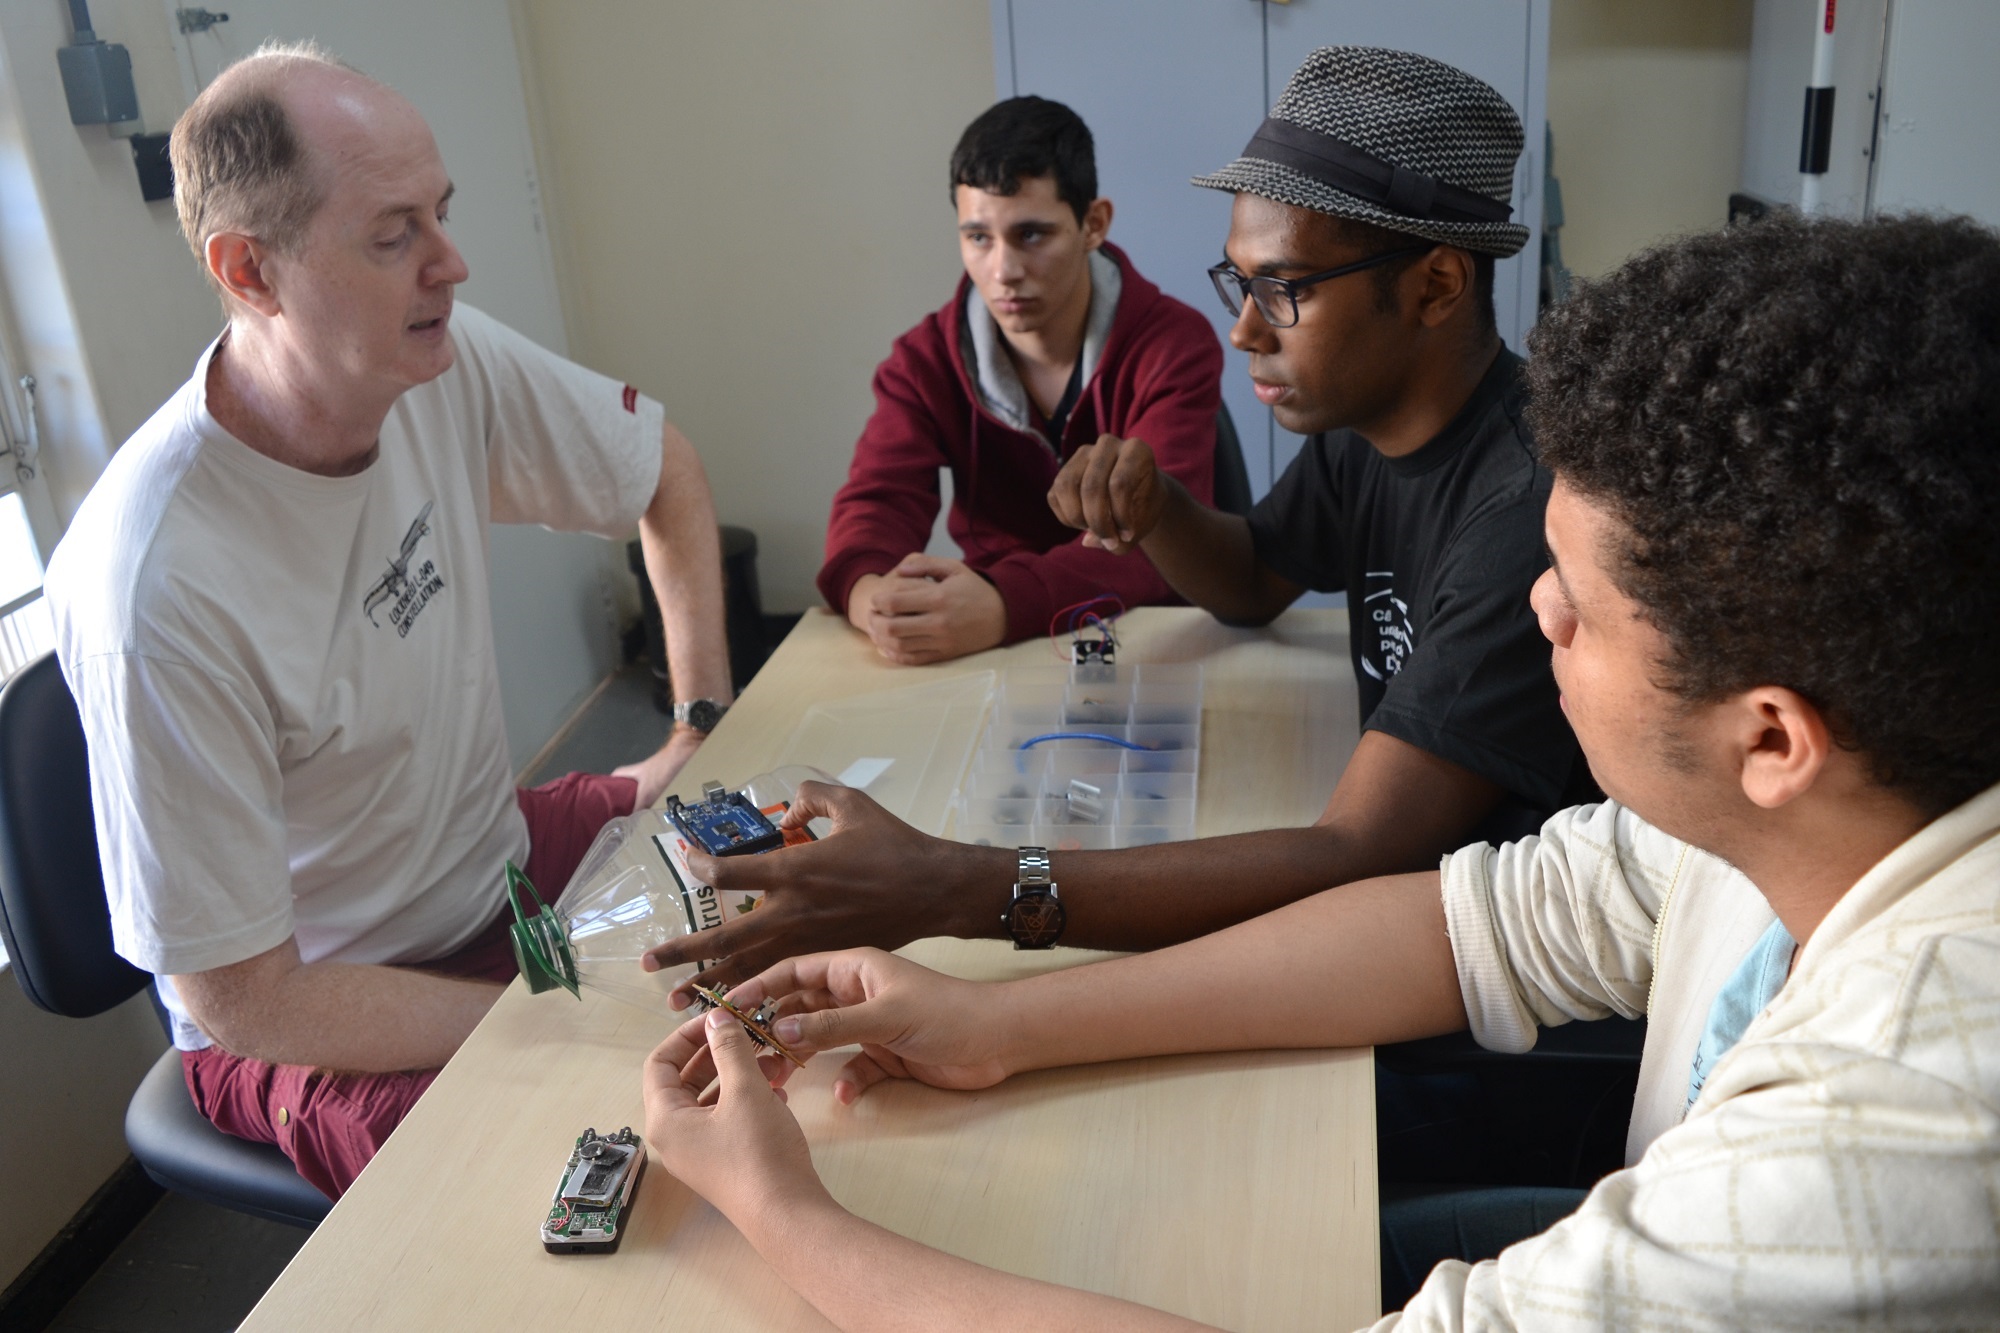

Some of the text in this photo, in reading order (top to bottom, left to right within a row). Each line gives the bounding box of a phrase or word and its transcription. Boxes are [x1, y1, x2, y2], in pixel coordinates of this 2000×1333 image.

[389, 560, 435, 626] LOCKHEED L-049
[397, 575, 444, 639] CONSTELLATION
